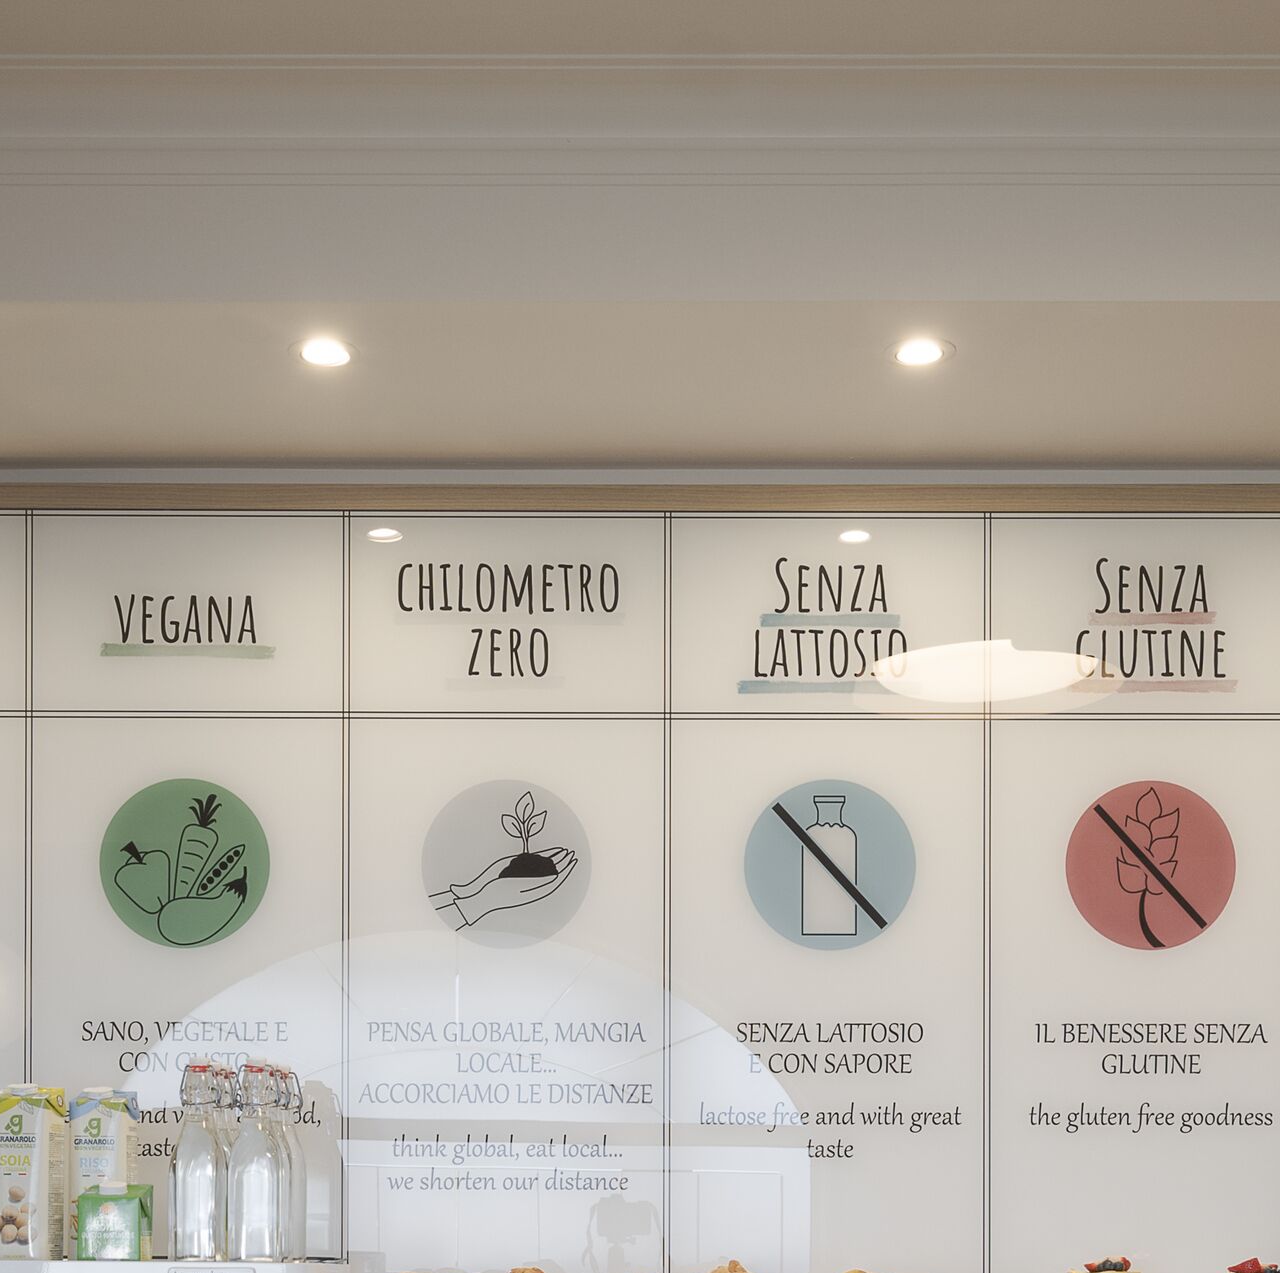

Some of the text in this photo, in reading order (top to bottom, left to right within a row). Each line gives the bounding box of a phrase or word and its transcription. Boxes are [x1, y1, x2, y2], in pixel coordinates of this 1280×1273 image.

[397, 561, 620, 615] CHILOMETRO
[774, 556, 887, 615] SENZA
[1095, 557, 1209, 616] SENZA
[115, 595, 257, 644] VEGANA
[466, 626, 551, 678] ZERO
[752, 627, 907, 680] LATTOSIO
[1076, 627, 1227, 680] GLUTINE
[81, 1021, 288, 1044] SANO, VEGETALE E
[367, 1021, 647, 1045] PENSA GLOBALE, MANGIA
[736, 1022, 924, 1043] SENZA LATTOSIO
[1035, 1023, 1268, 1043] IL BENESSERE SENZA
[119, 1052, 168, 1073] CON
[456, 1052, 557, 1073] LOCALE...
[749, 1053, 912, 1074] E CON SAPORE
[1101, 1054, 1202, 1074] GLUTINE
[358, 1083, 654, 1104] ACCORCIAMO LE DISTANZE
[137, 1100, 168, 1124] nd
[700, 1102, 962, 1133] lactose free and with great
[1029, 1102, 1273, 1133] the gluten free goodness
[74, 1138, 115, 1146] GRANAROLO
[392, 1134, 623, 1165] think global, eat local...
[807, 1139, 854, 1158] taste
[0, 1154, 31, 1166] SOIA
[79, 1157, 109, 1168] RISO
[387, 1167, 629, 1190] we shorten our distance
